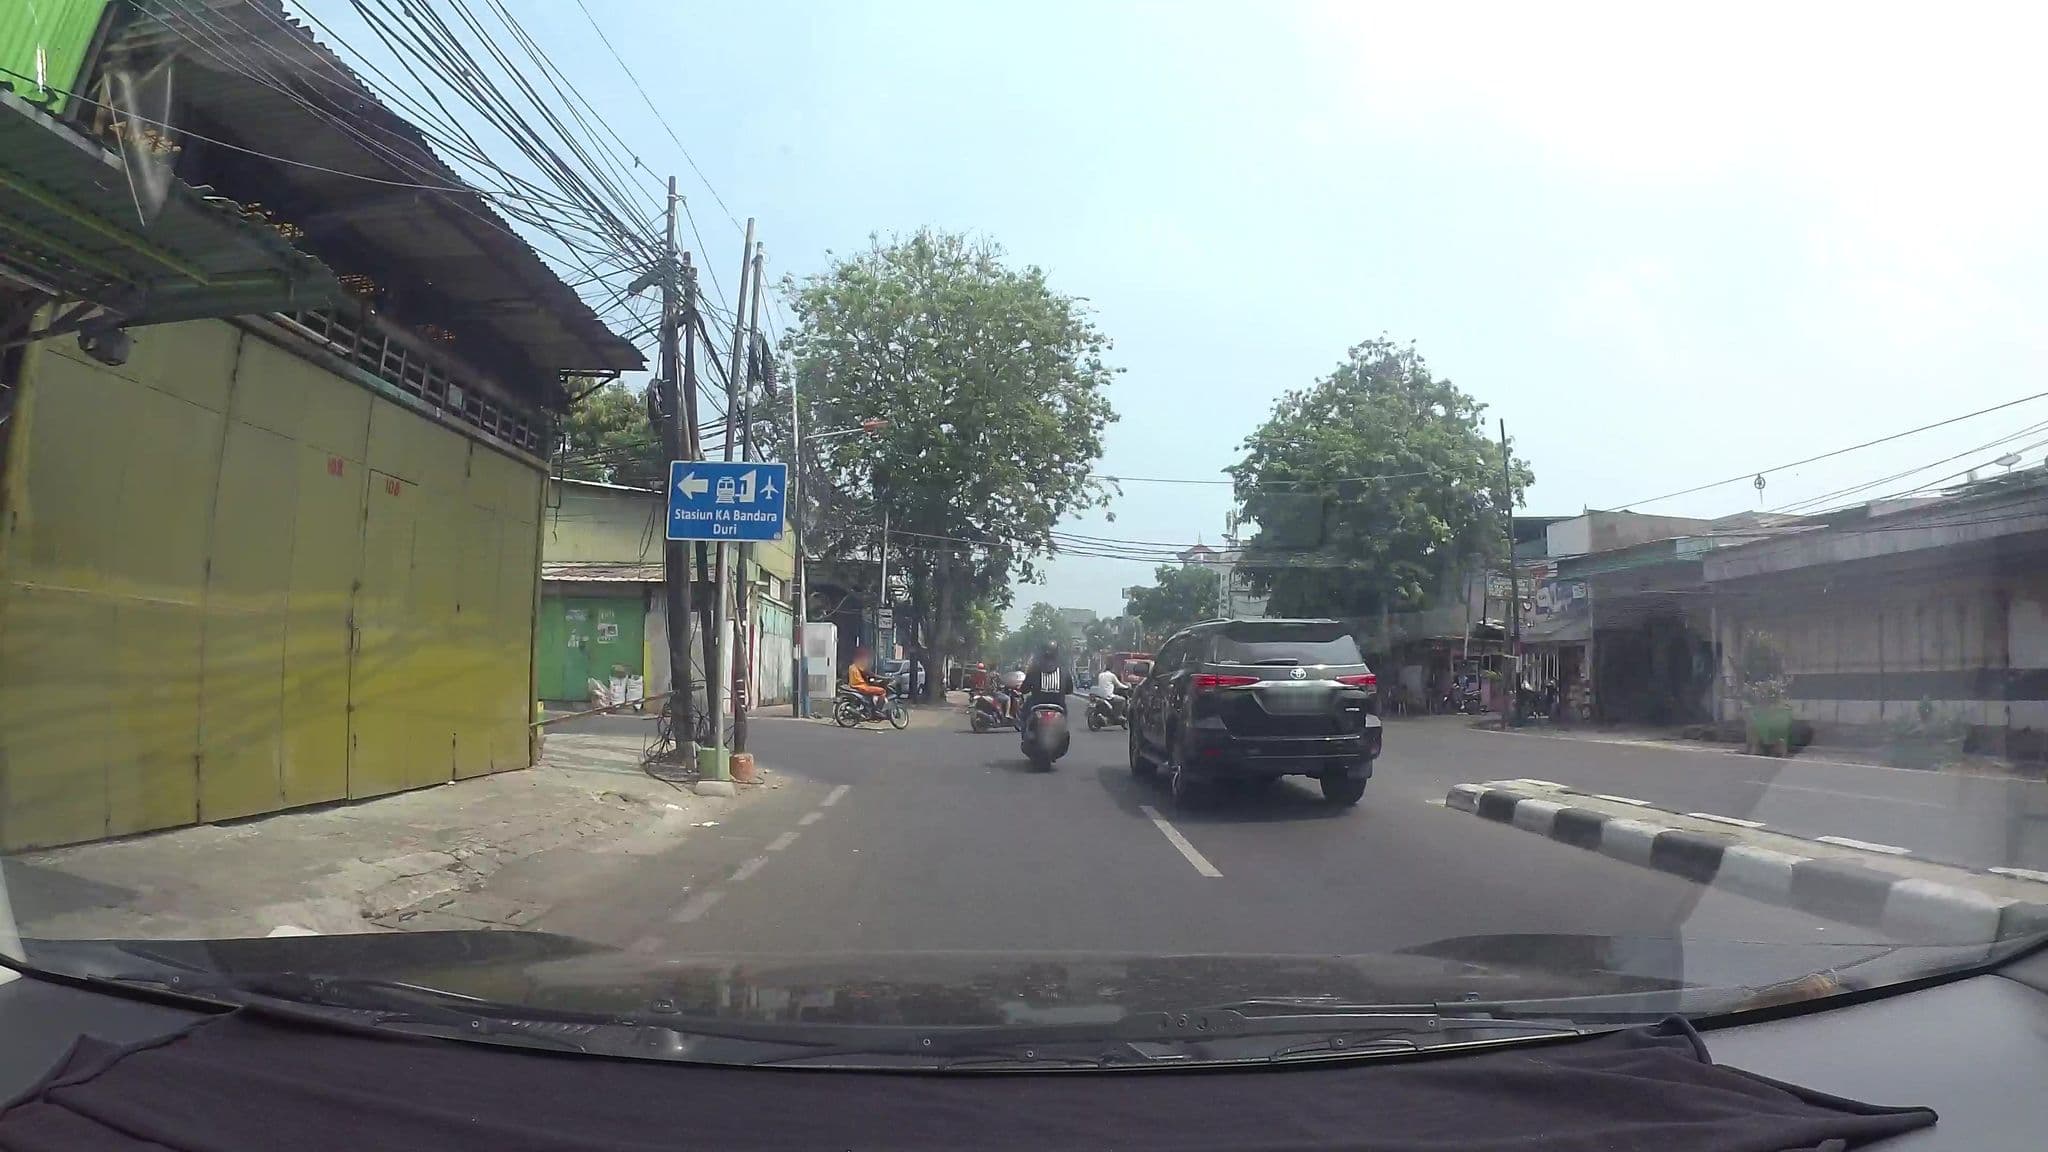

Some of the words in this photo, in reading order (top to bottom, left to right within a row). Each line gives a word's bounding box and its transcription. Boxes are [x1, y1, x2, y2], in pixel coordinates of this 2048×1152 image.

[674, 509, 713, 521] Stasiun
[715, 509, 730, 521] KA
[733, 510, 777, 522] Bandara
[713, 523, 737, 535] Duri
